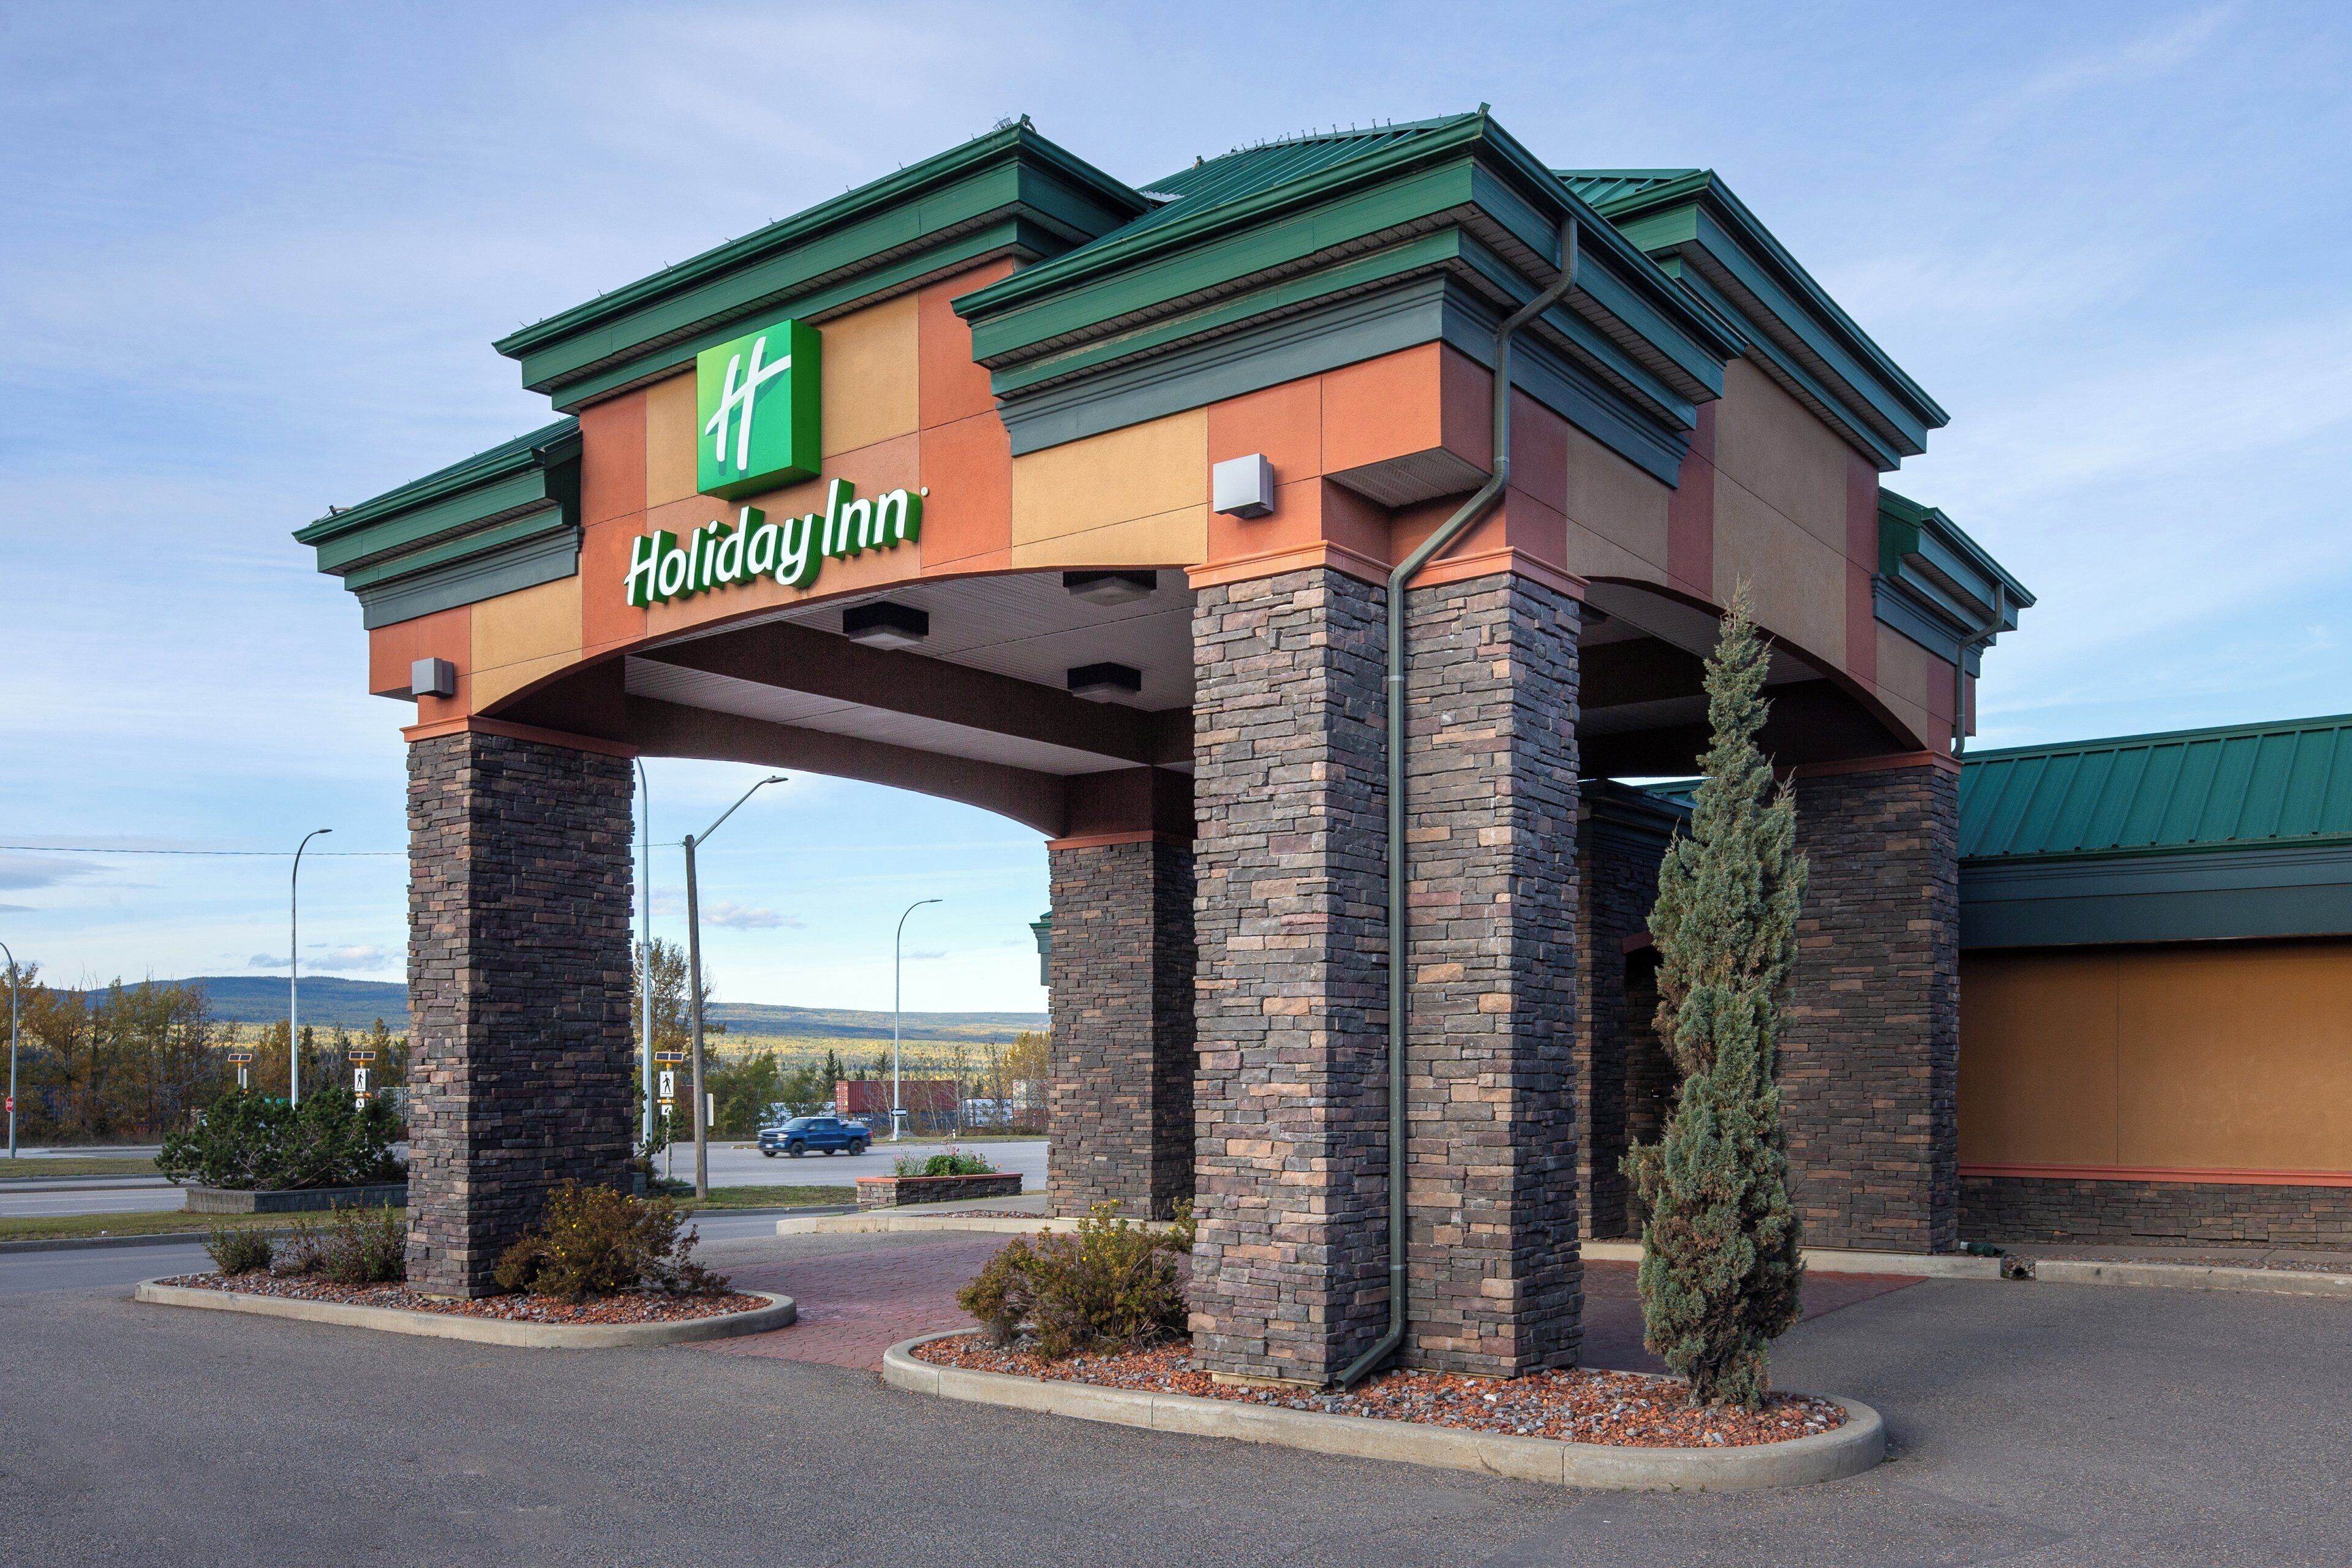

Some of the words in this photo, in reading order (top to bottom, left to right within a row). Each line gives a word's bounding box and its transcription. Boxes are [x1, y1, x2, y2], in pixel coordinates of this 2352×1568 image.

[704, 336, 791, 471] H
[623, 505, 815, 606] Holiday
[821, 477, 910, 557] Inn
